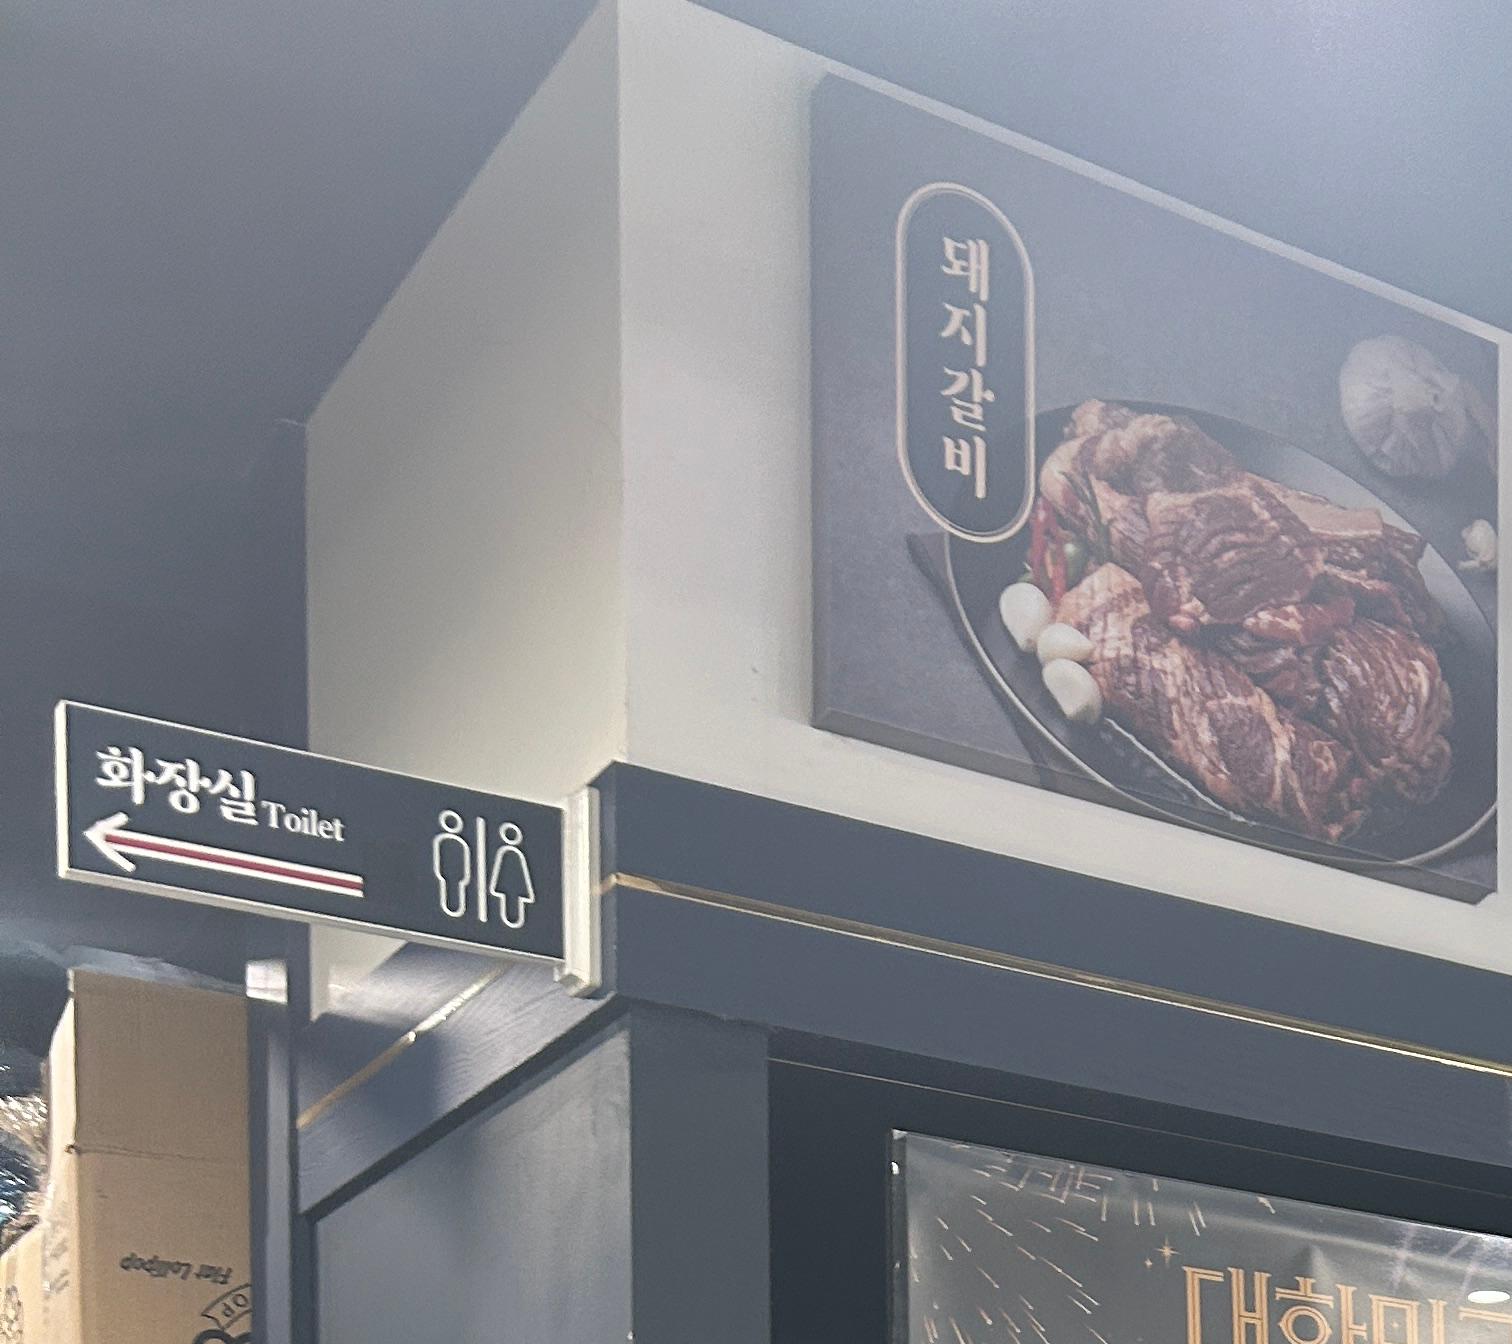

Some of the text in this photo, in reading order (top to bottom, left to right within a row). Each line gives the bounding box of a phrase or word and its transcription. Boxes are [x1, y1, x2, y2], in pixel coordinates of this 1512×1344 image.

[940, 236, 996, 499] 돼지갈비
[95, 746, 259, 825] 화장실
[261, 800, 345, 842] Toilet
